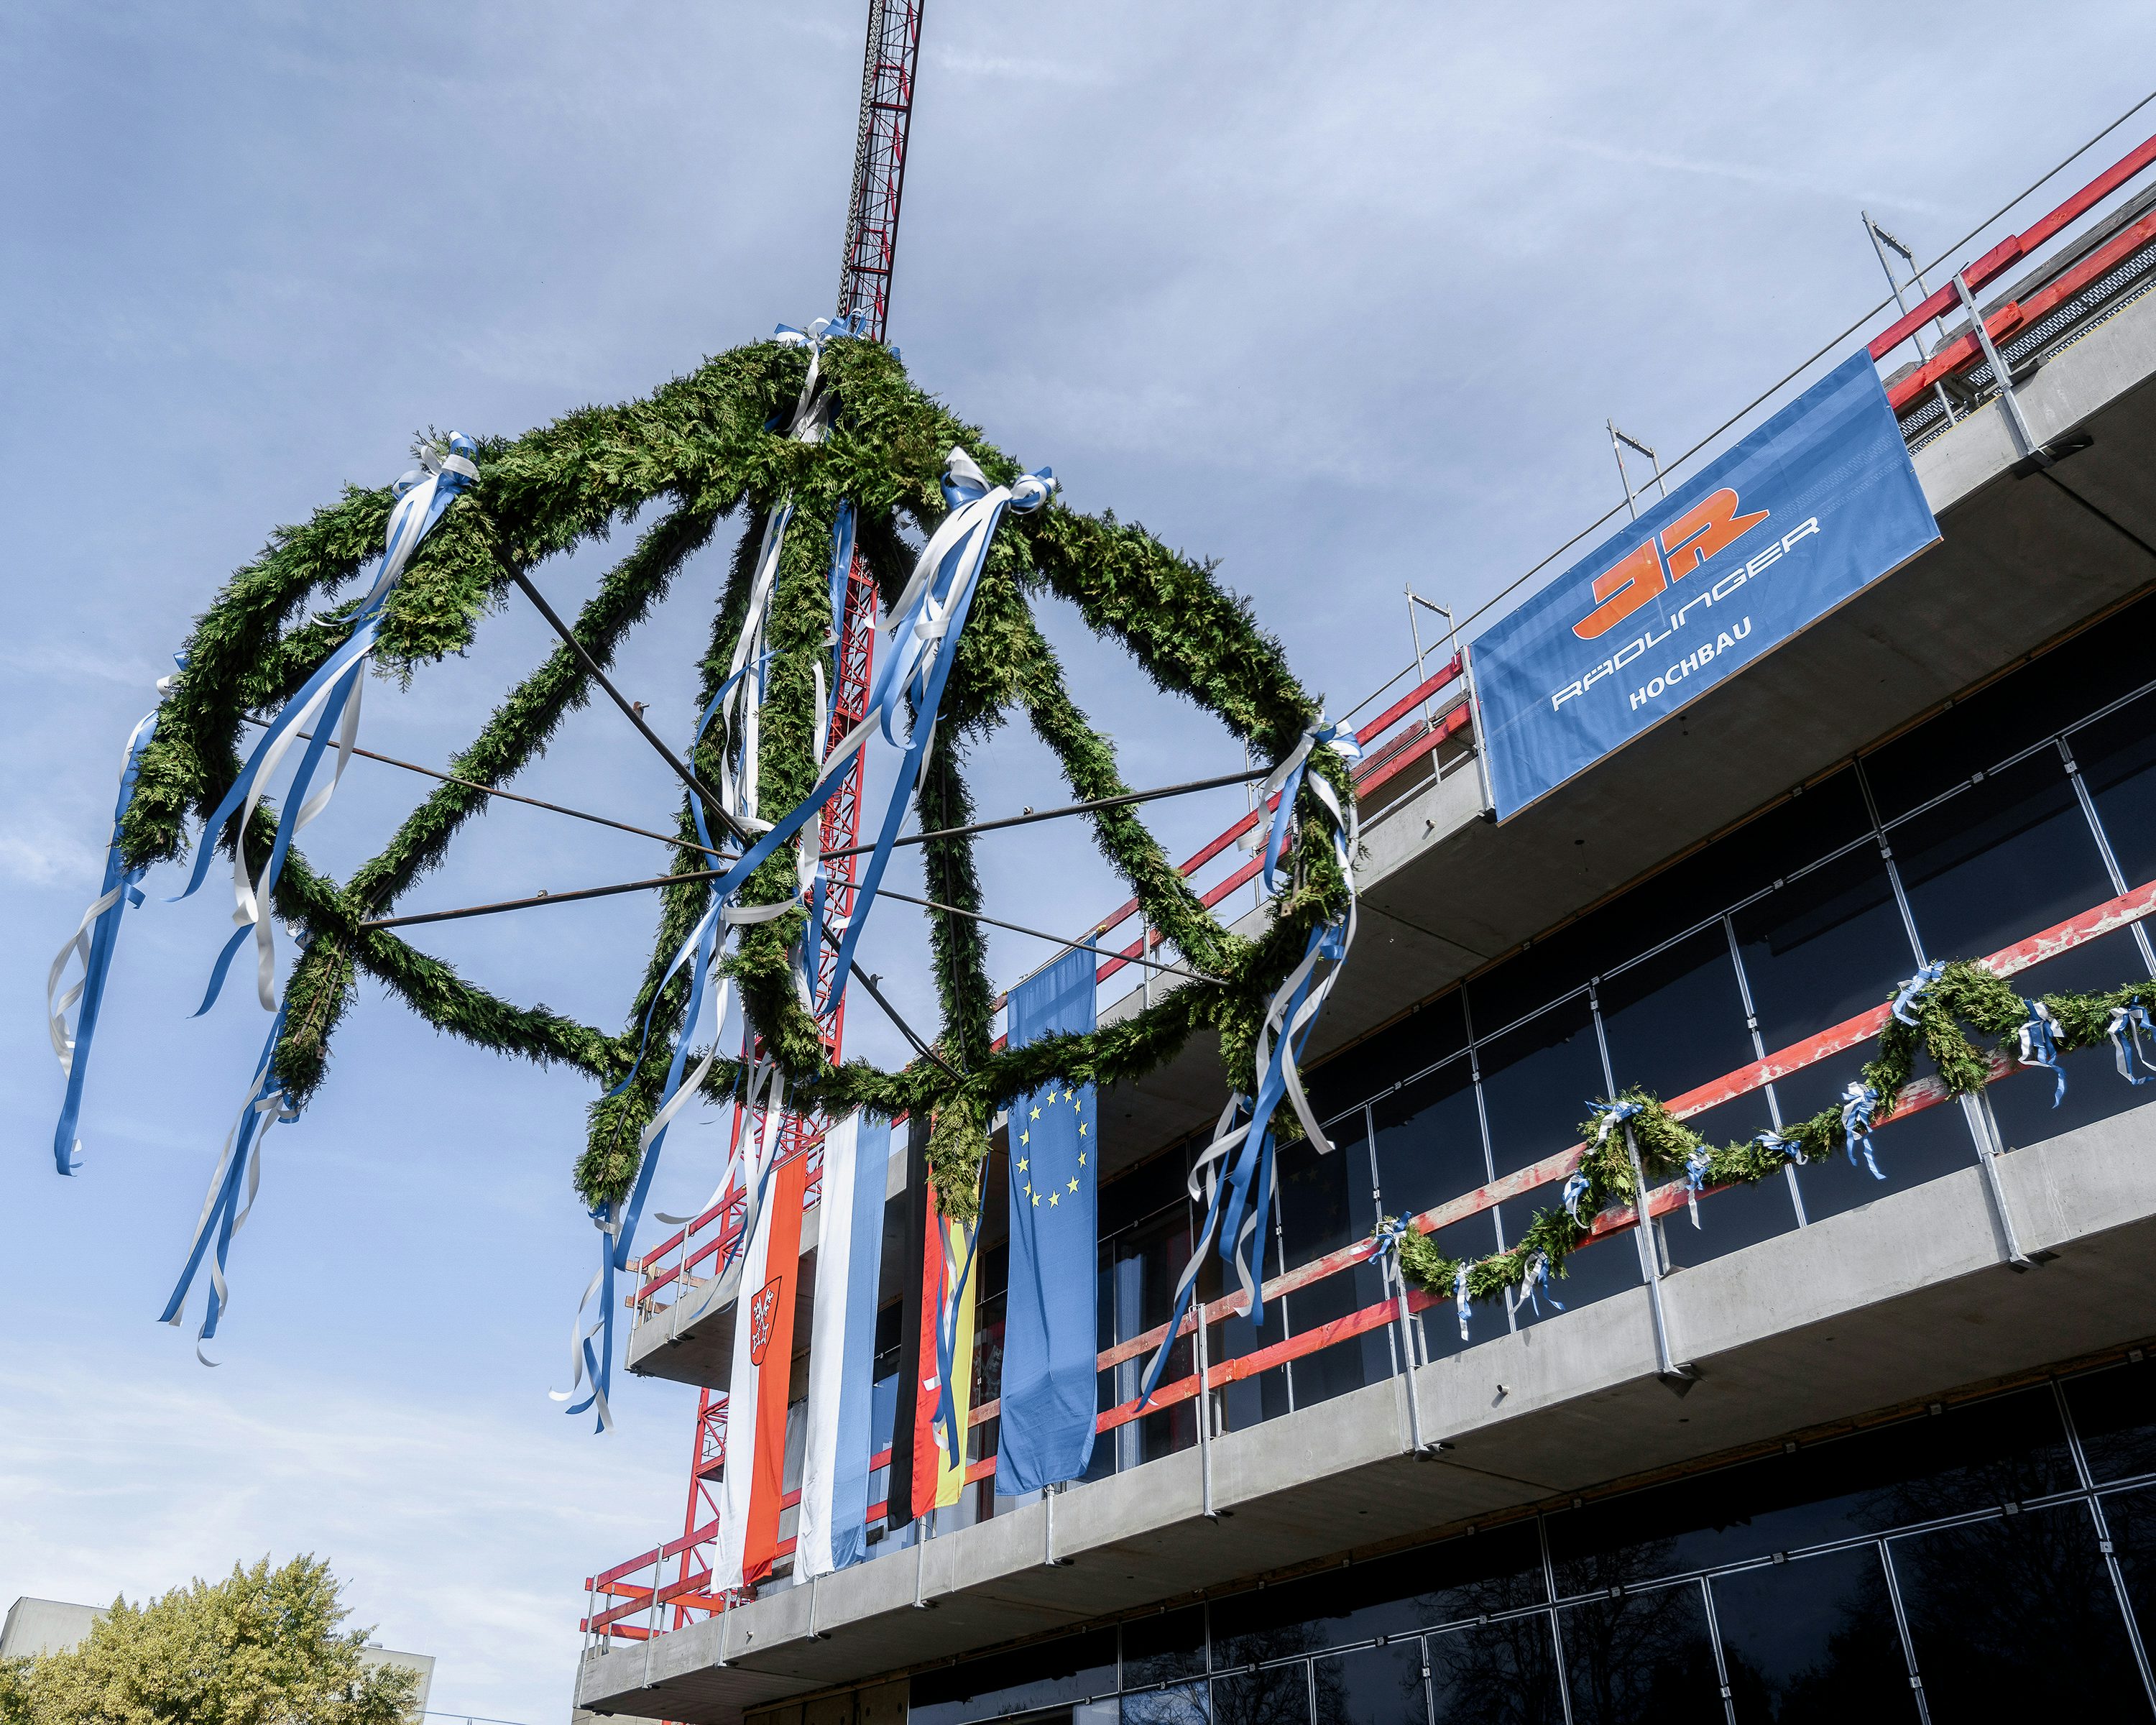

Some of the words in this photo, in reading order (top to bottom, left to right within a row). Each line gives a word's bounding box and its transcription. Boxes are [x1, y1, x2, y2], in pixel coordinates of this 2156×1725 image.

[1551, 517, 1820, 712] RÄDLINGER
[1572, 487, 1771, 640] JR
[1628, 615, 1751, 711] HOCHBAU
